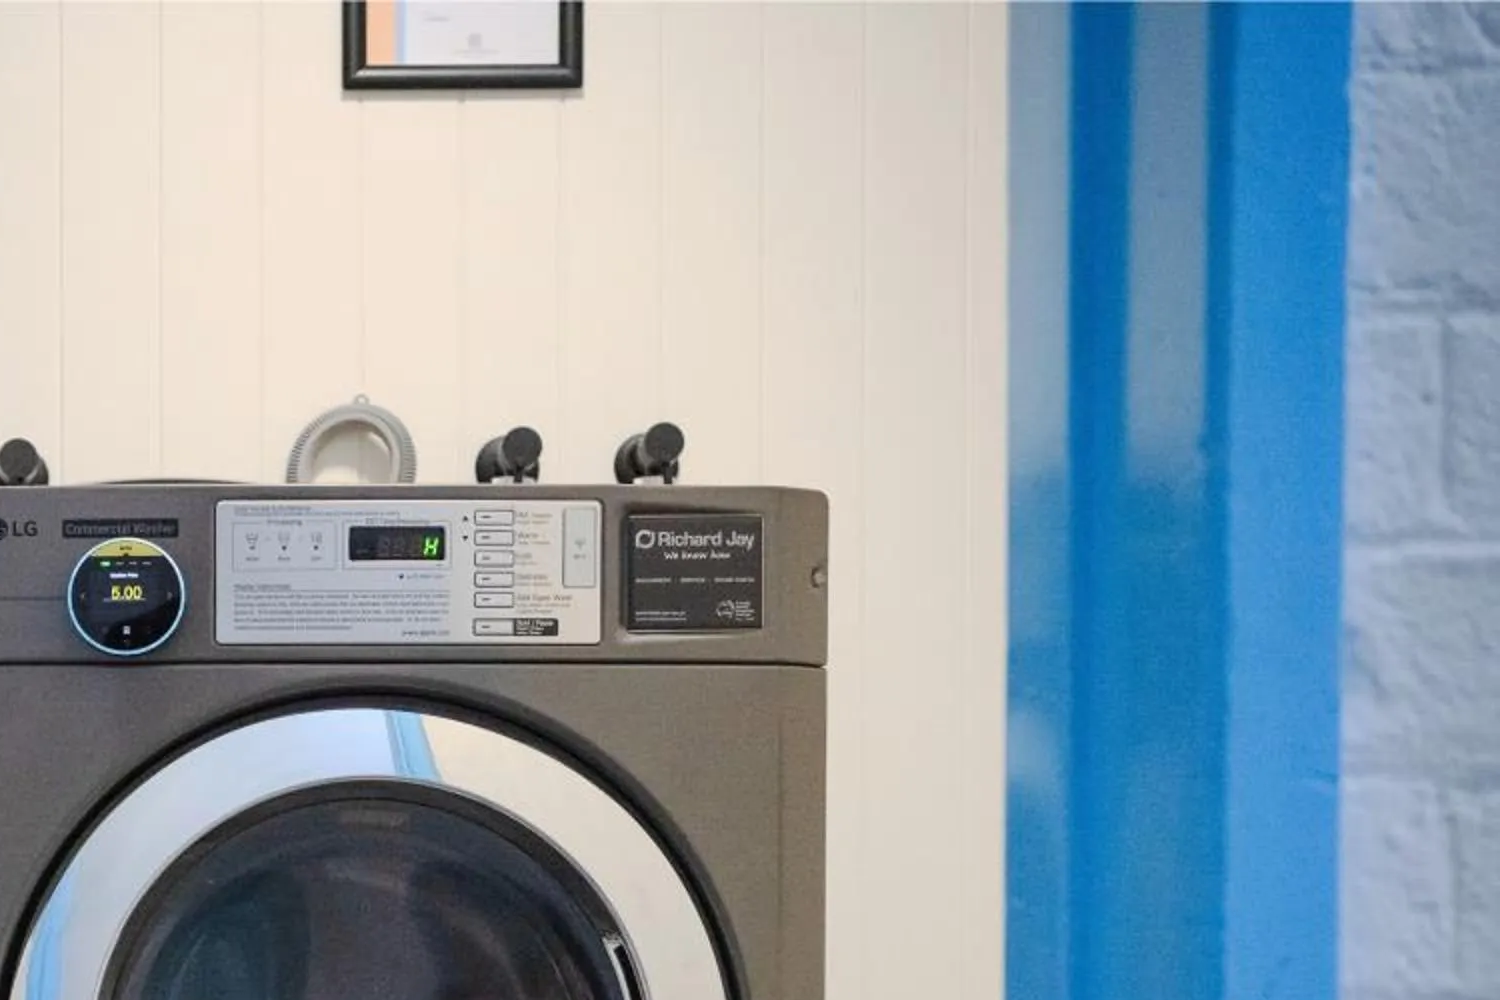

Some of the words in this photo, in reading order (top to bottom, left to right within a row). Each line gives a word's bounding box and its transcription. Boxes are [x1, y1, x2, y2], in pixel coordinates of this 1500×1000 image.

[12, 520, 38, 537] LG
[657, 530, 722, 547] Richard
[725, 531, 755, 551] Jay
[111, 585, 143, 601] 5.00
